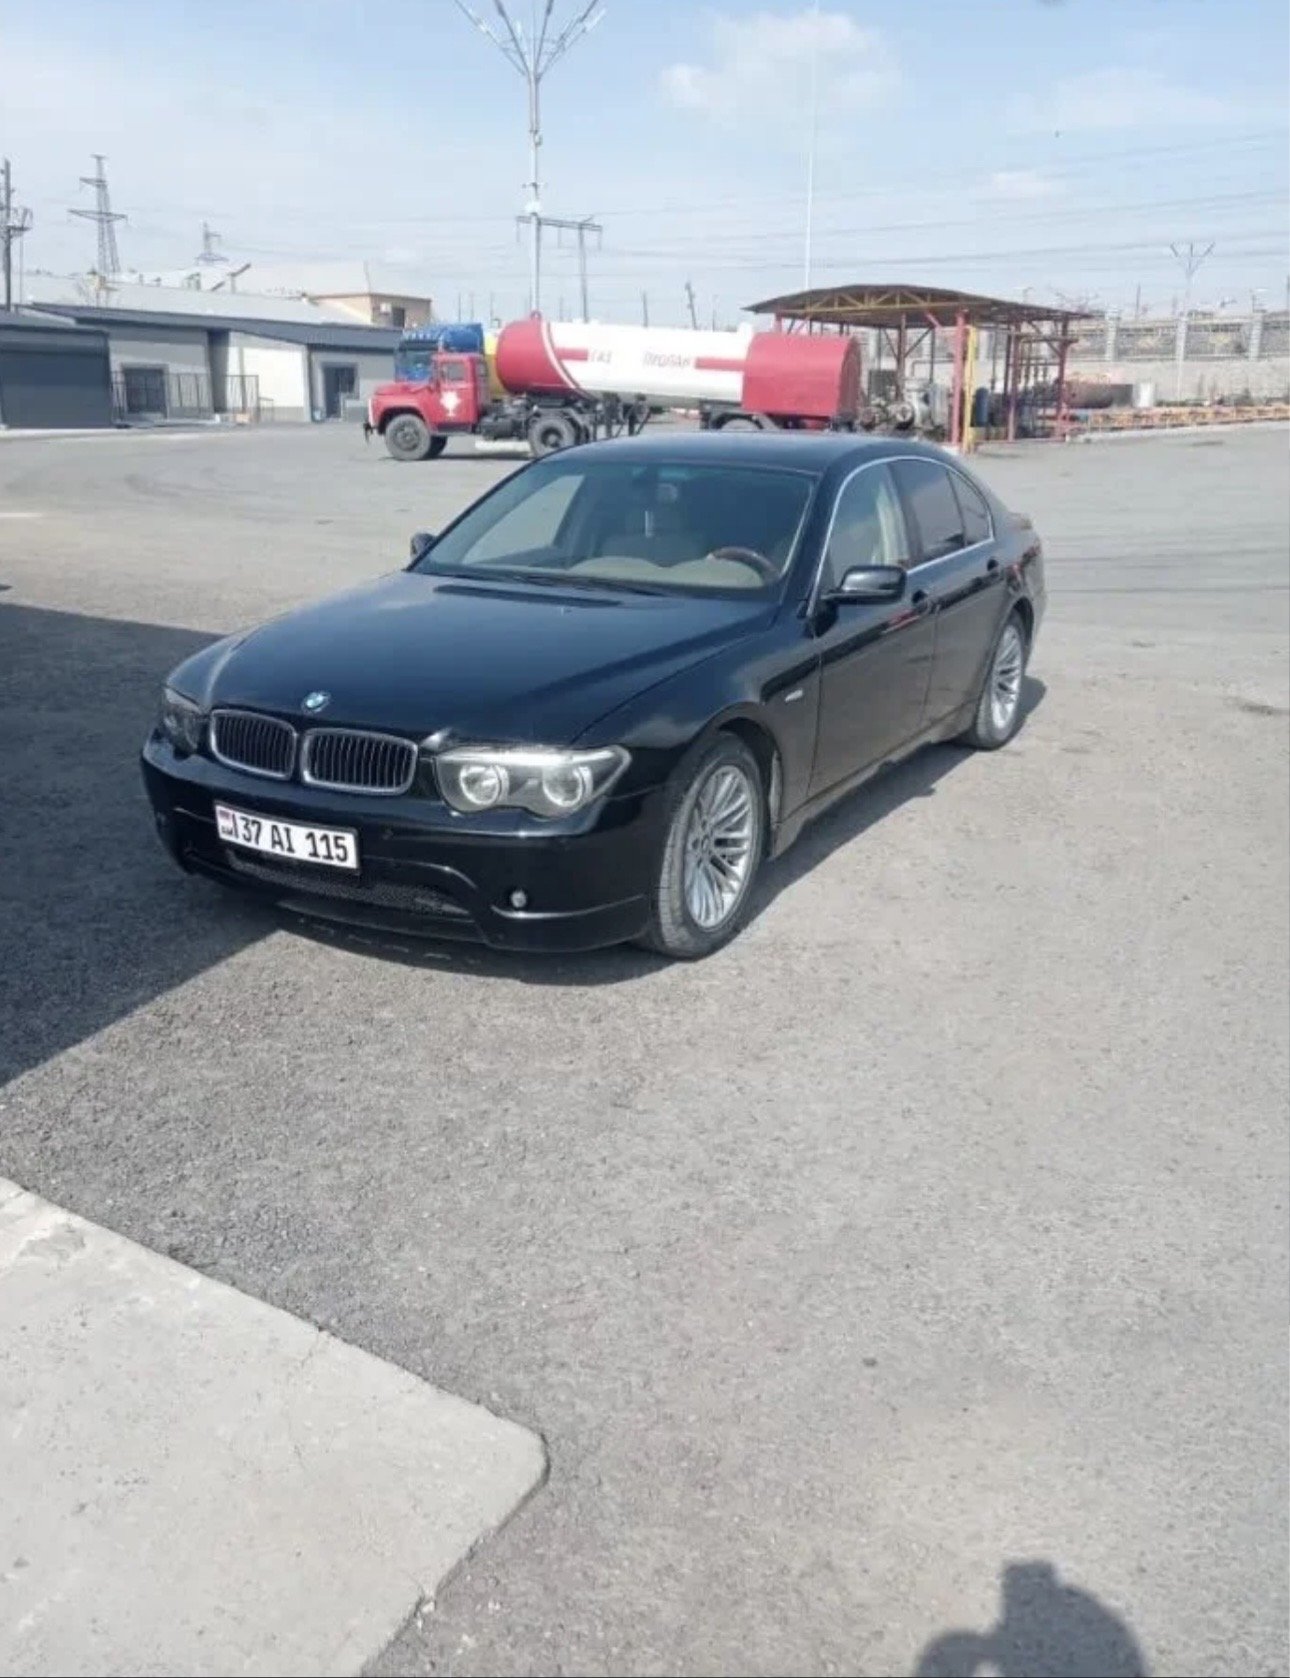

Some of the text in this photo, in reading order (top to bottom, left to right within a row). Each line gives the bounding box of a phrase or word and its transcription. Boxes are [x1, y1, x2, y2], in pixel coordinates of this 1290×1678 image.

[239, 816, 349, 863] 37 AI 115
